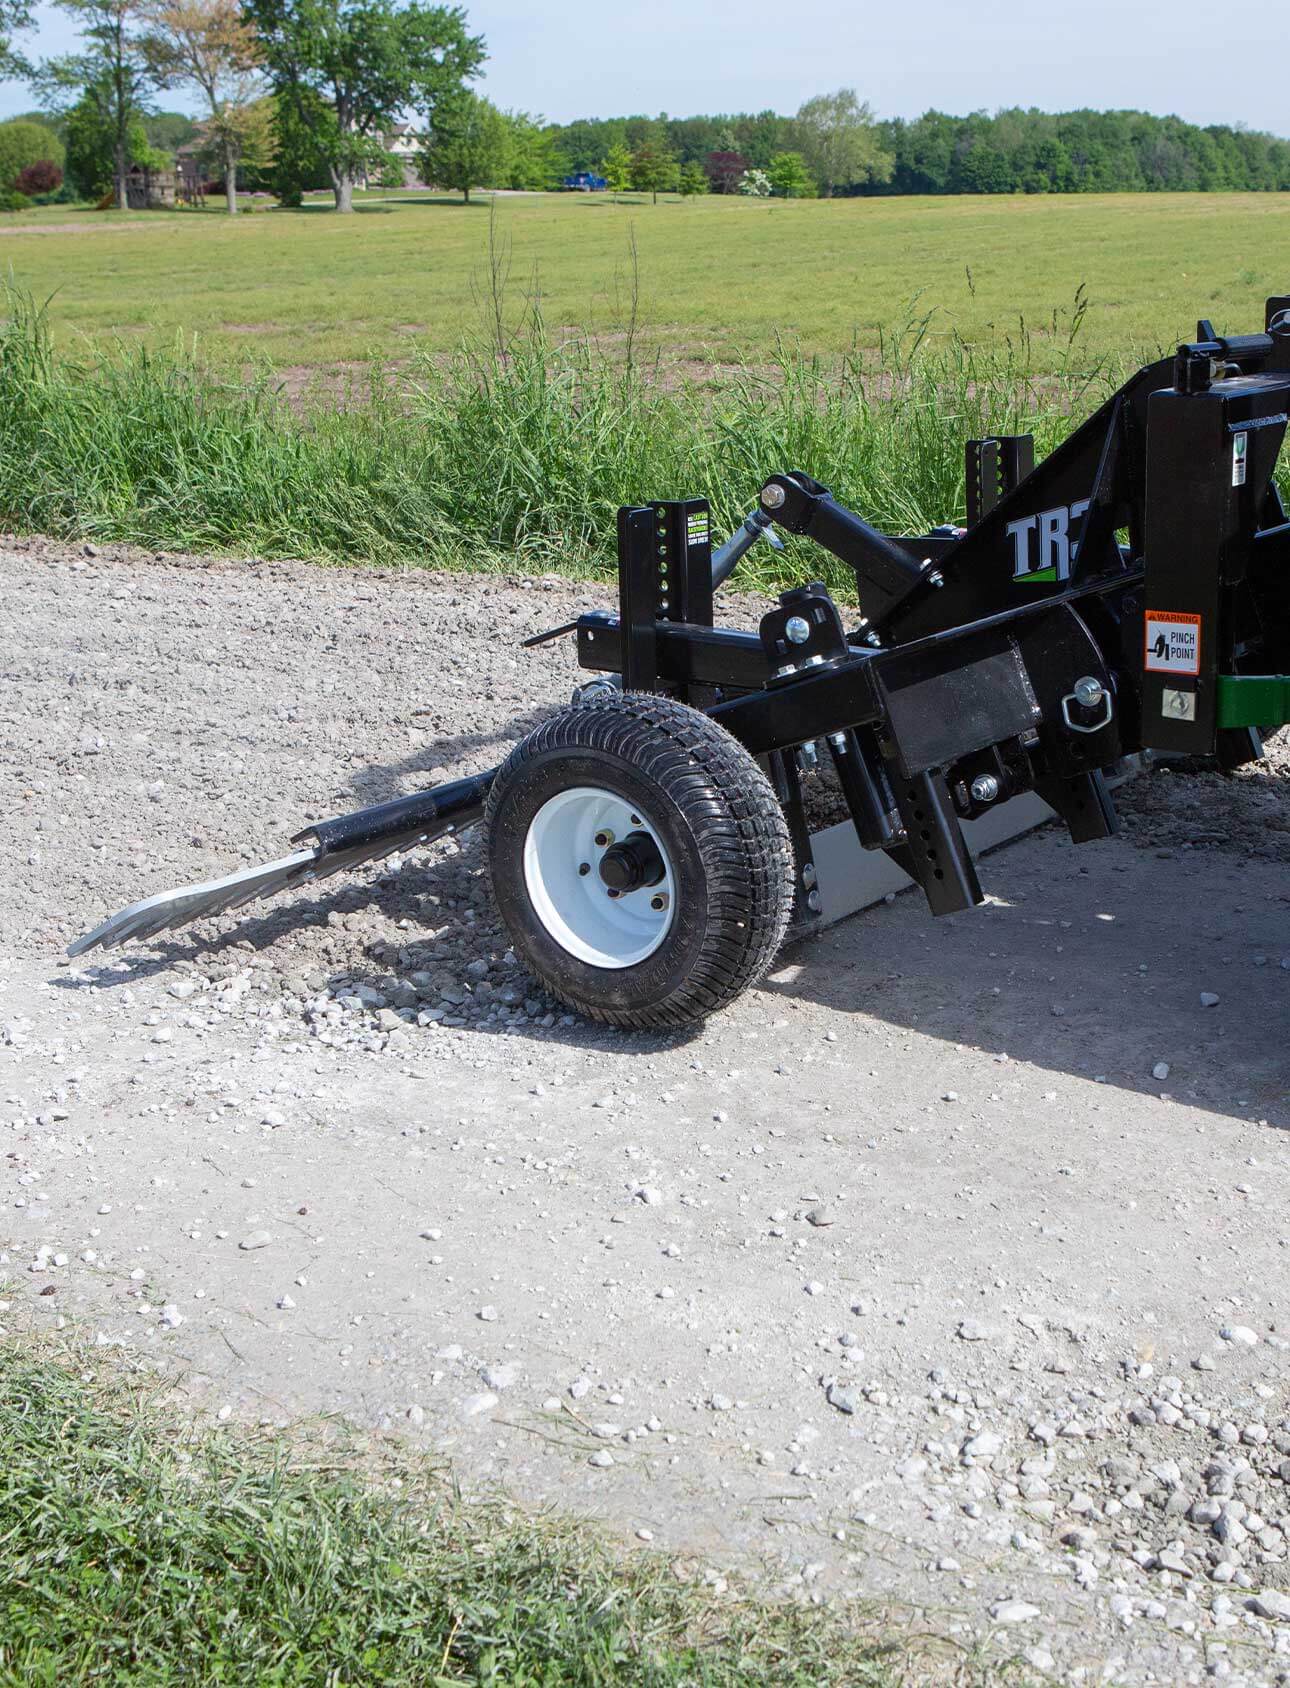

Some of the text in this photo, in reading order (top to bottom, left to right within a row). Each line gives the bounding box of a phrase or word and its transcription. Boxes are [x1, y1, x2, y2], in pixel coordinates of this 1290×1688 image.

[1157, 613, 1198, 623] WARNING
[1170, 632, 1195, 644] PINCH
[1170, 647, 1195, 660] POINT
